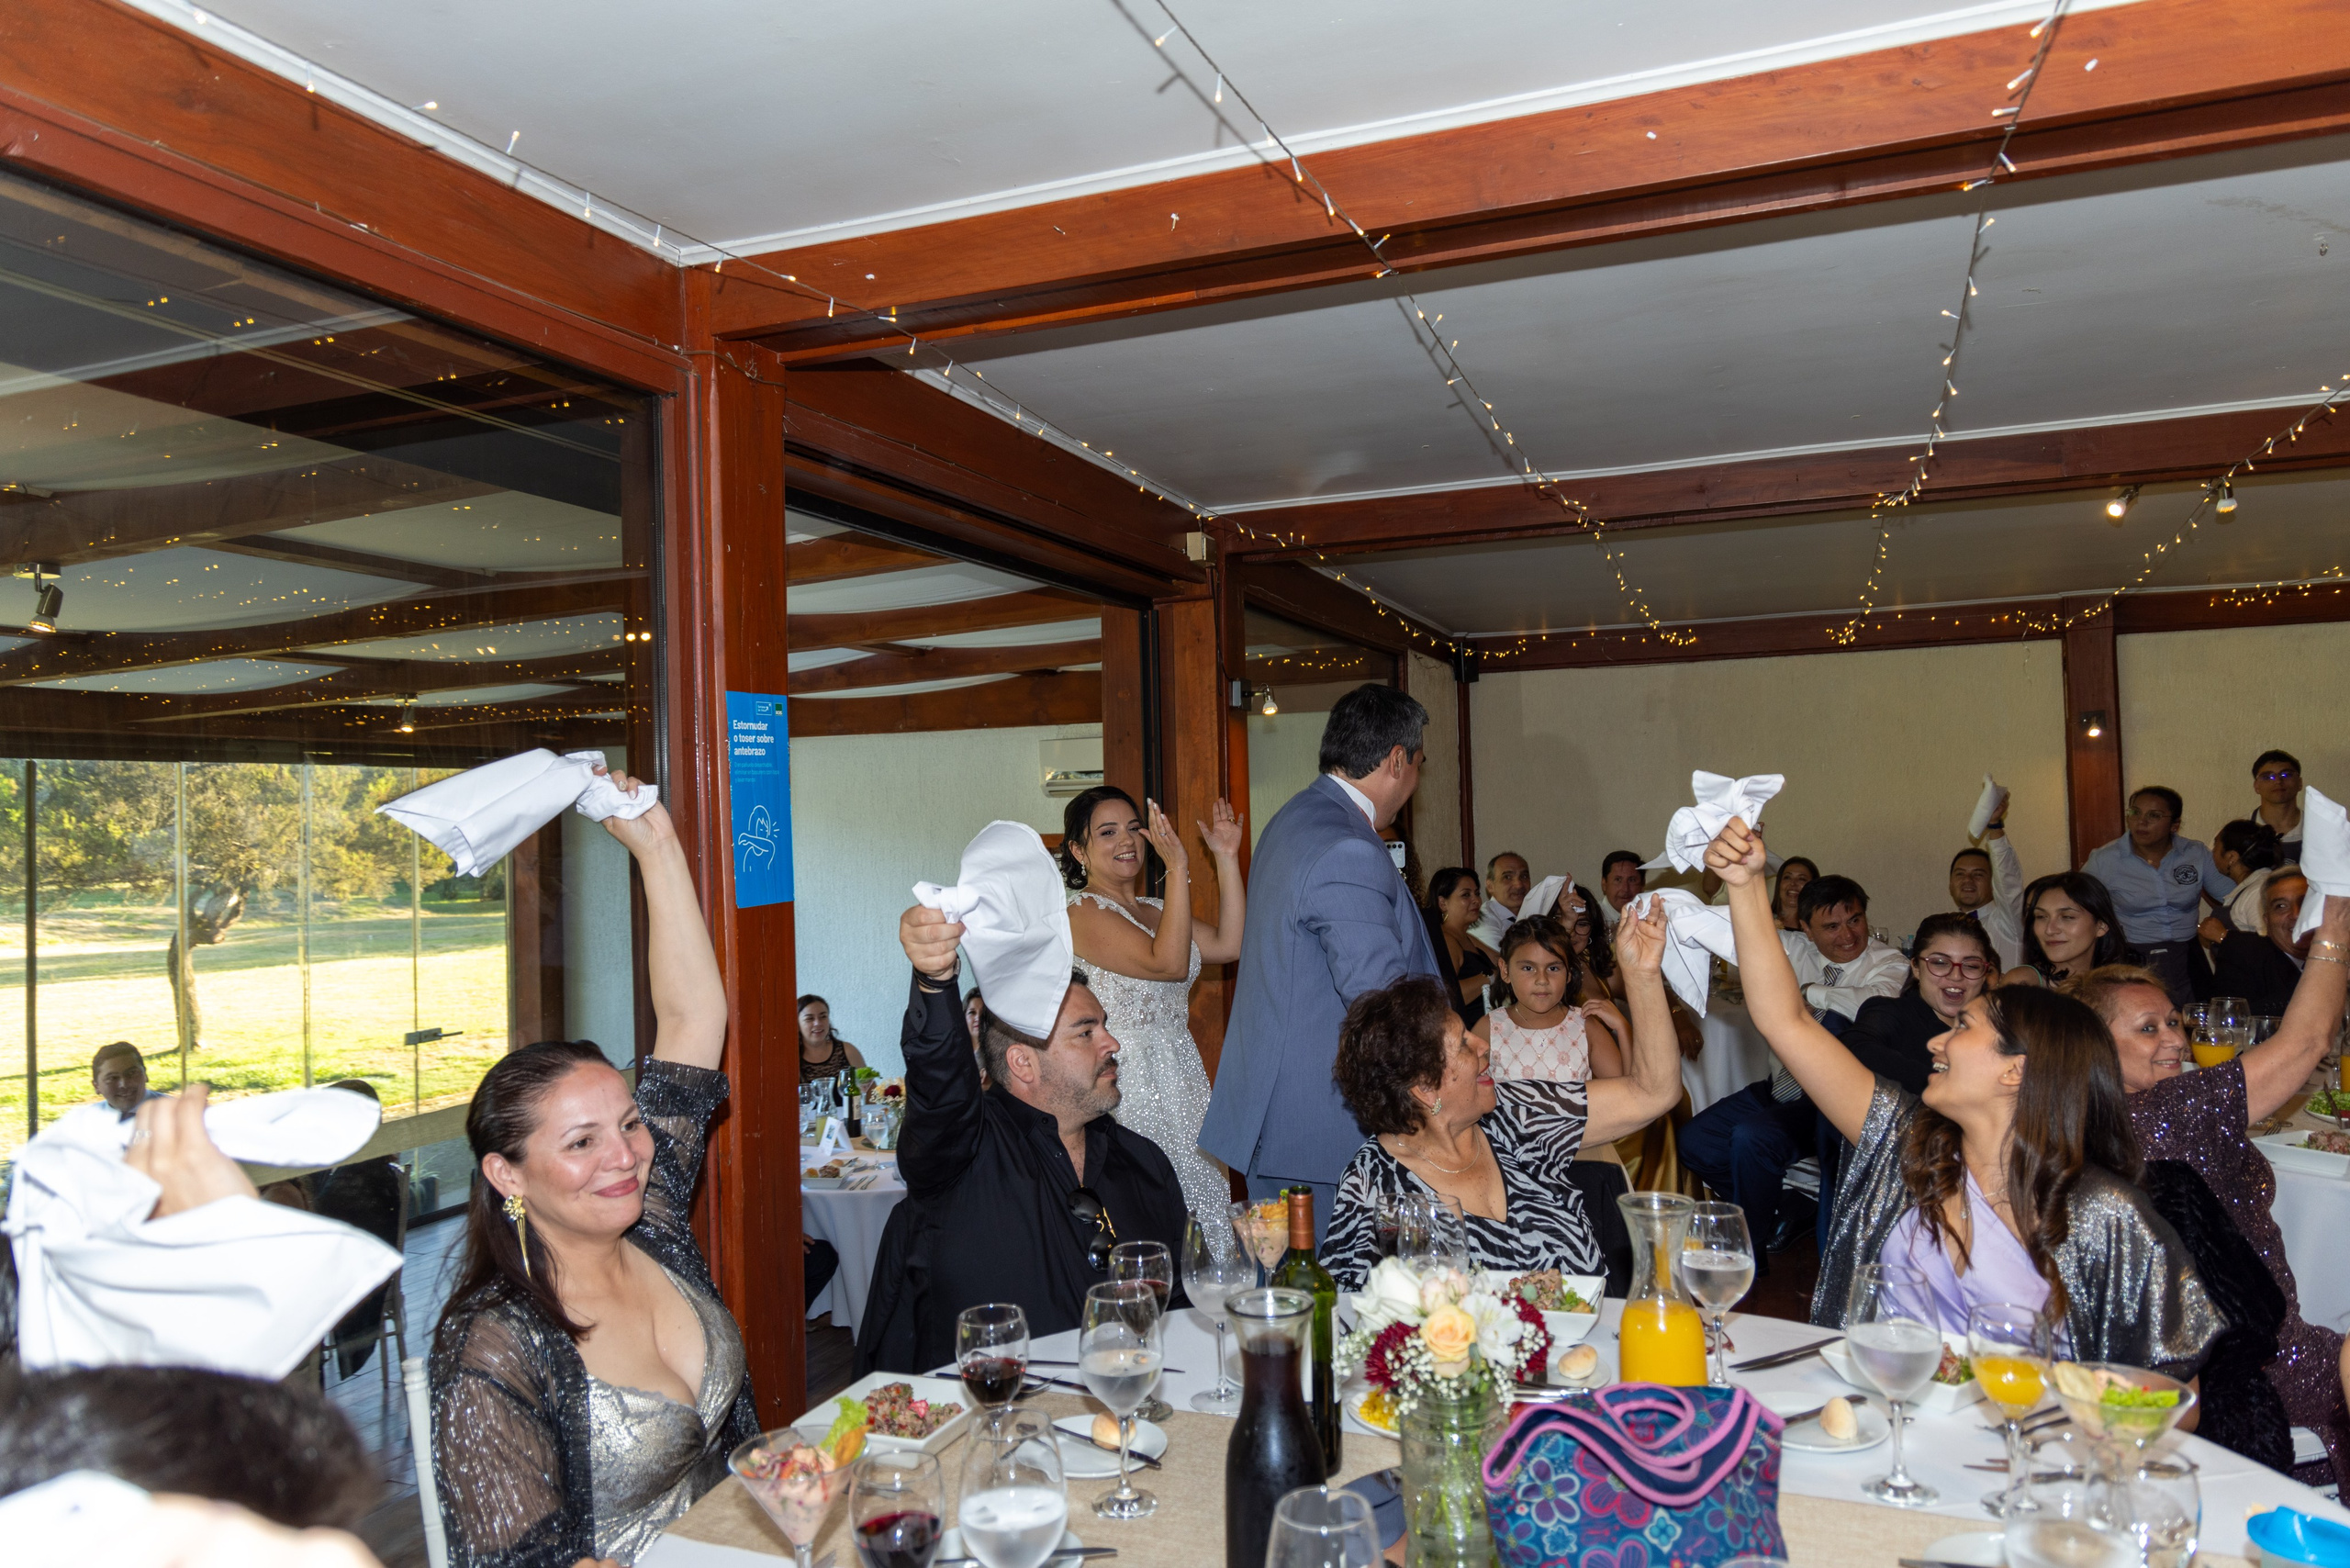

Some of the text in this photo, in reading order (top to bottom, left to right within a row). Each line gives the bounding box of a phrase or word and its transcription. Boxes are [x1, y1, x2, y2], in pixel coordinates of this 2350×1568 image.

[733, 720, 768, 730] Estornudar
[739, 734, 755, 743] toser
[756, 734, 774, 743] sobre
[734, 746, 766, 756] antebrazo
